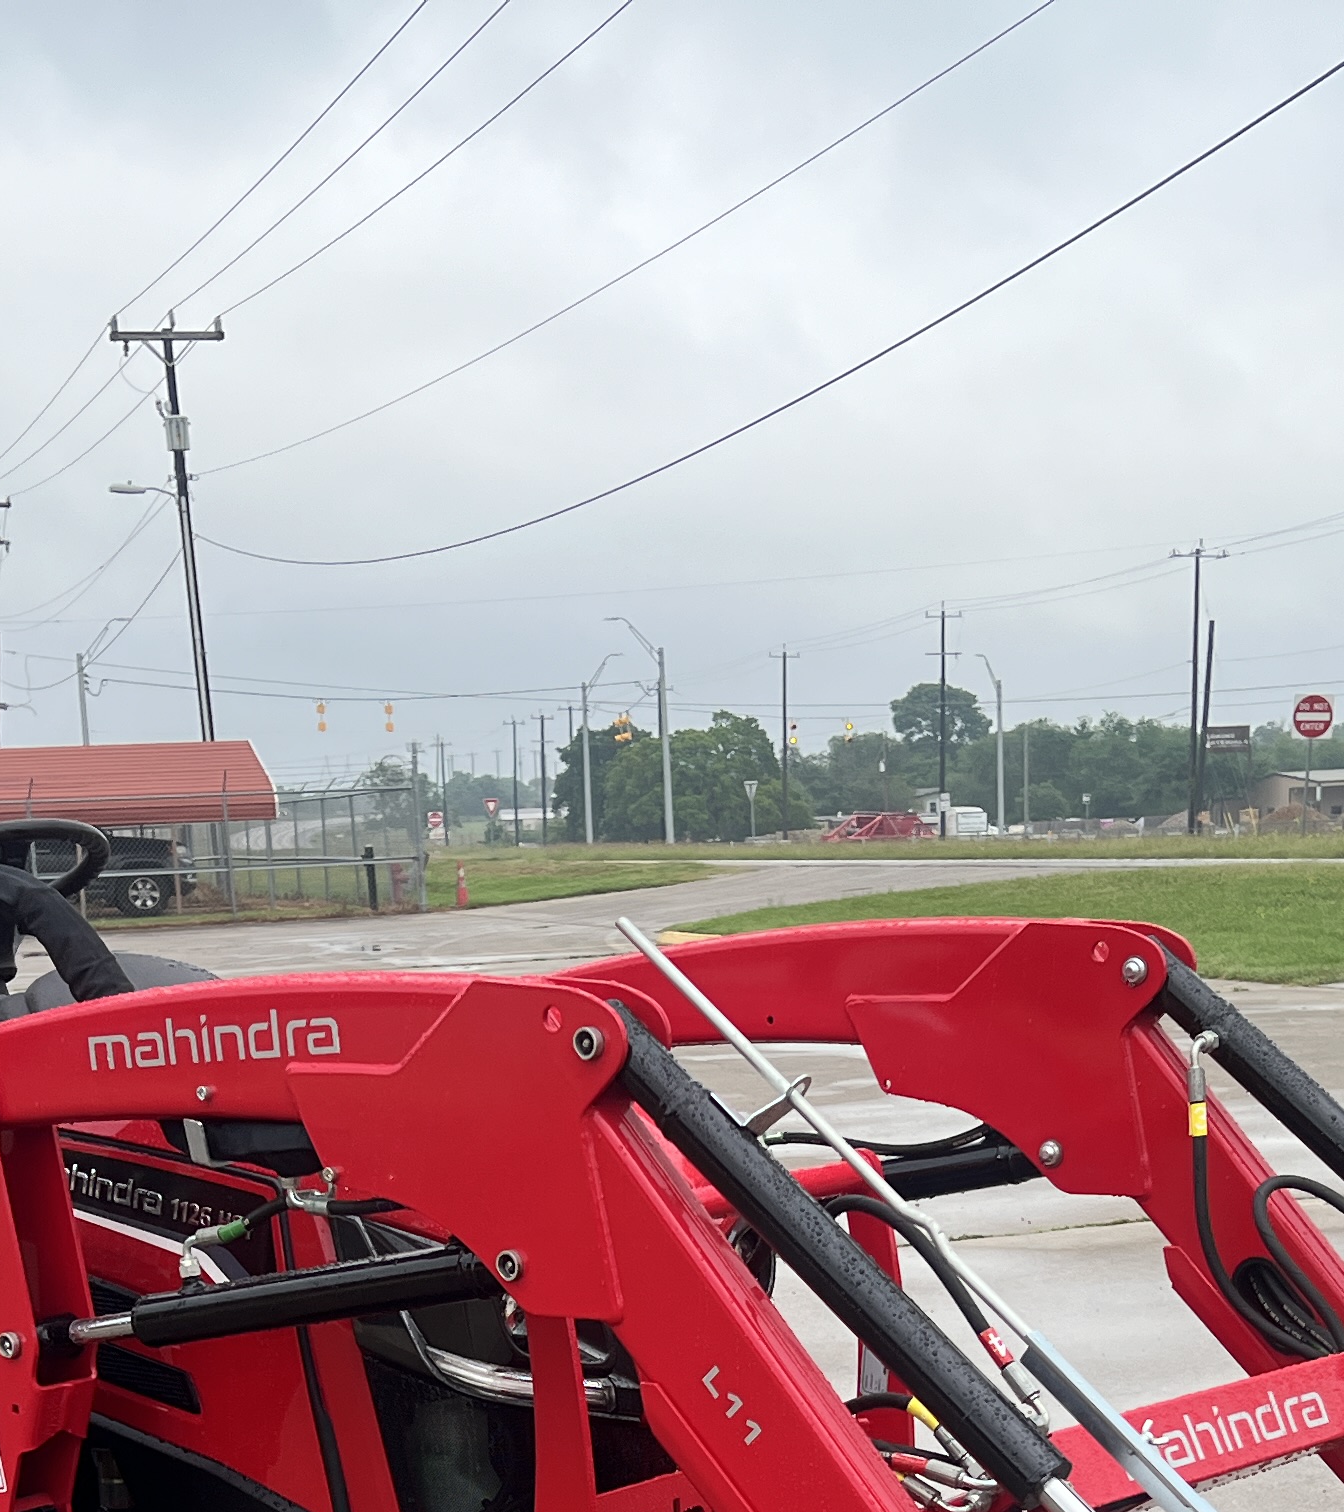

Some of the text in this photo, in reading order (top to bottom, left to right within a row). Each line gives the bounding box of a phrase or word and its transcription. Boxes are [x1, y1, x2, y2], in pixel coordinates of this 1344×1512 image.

[1299, 702, 1329, 711] DO NOT
[1300, 721, 1325, 731] ENTER
[88, 1008, 341, 1071] mahindra
[64, 1163, 163, 1216] hindra
[170, 1197, 213, 1227] 1126
[701, 1365, 762, 1446] L11
[1158, 1391, 1330, 1469] ahindra
